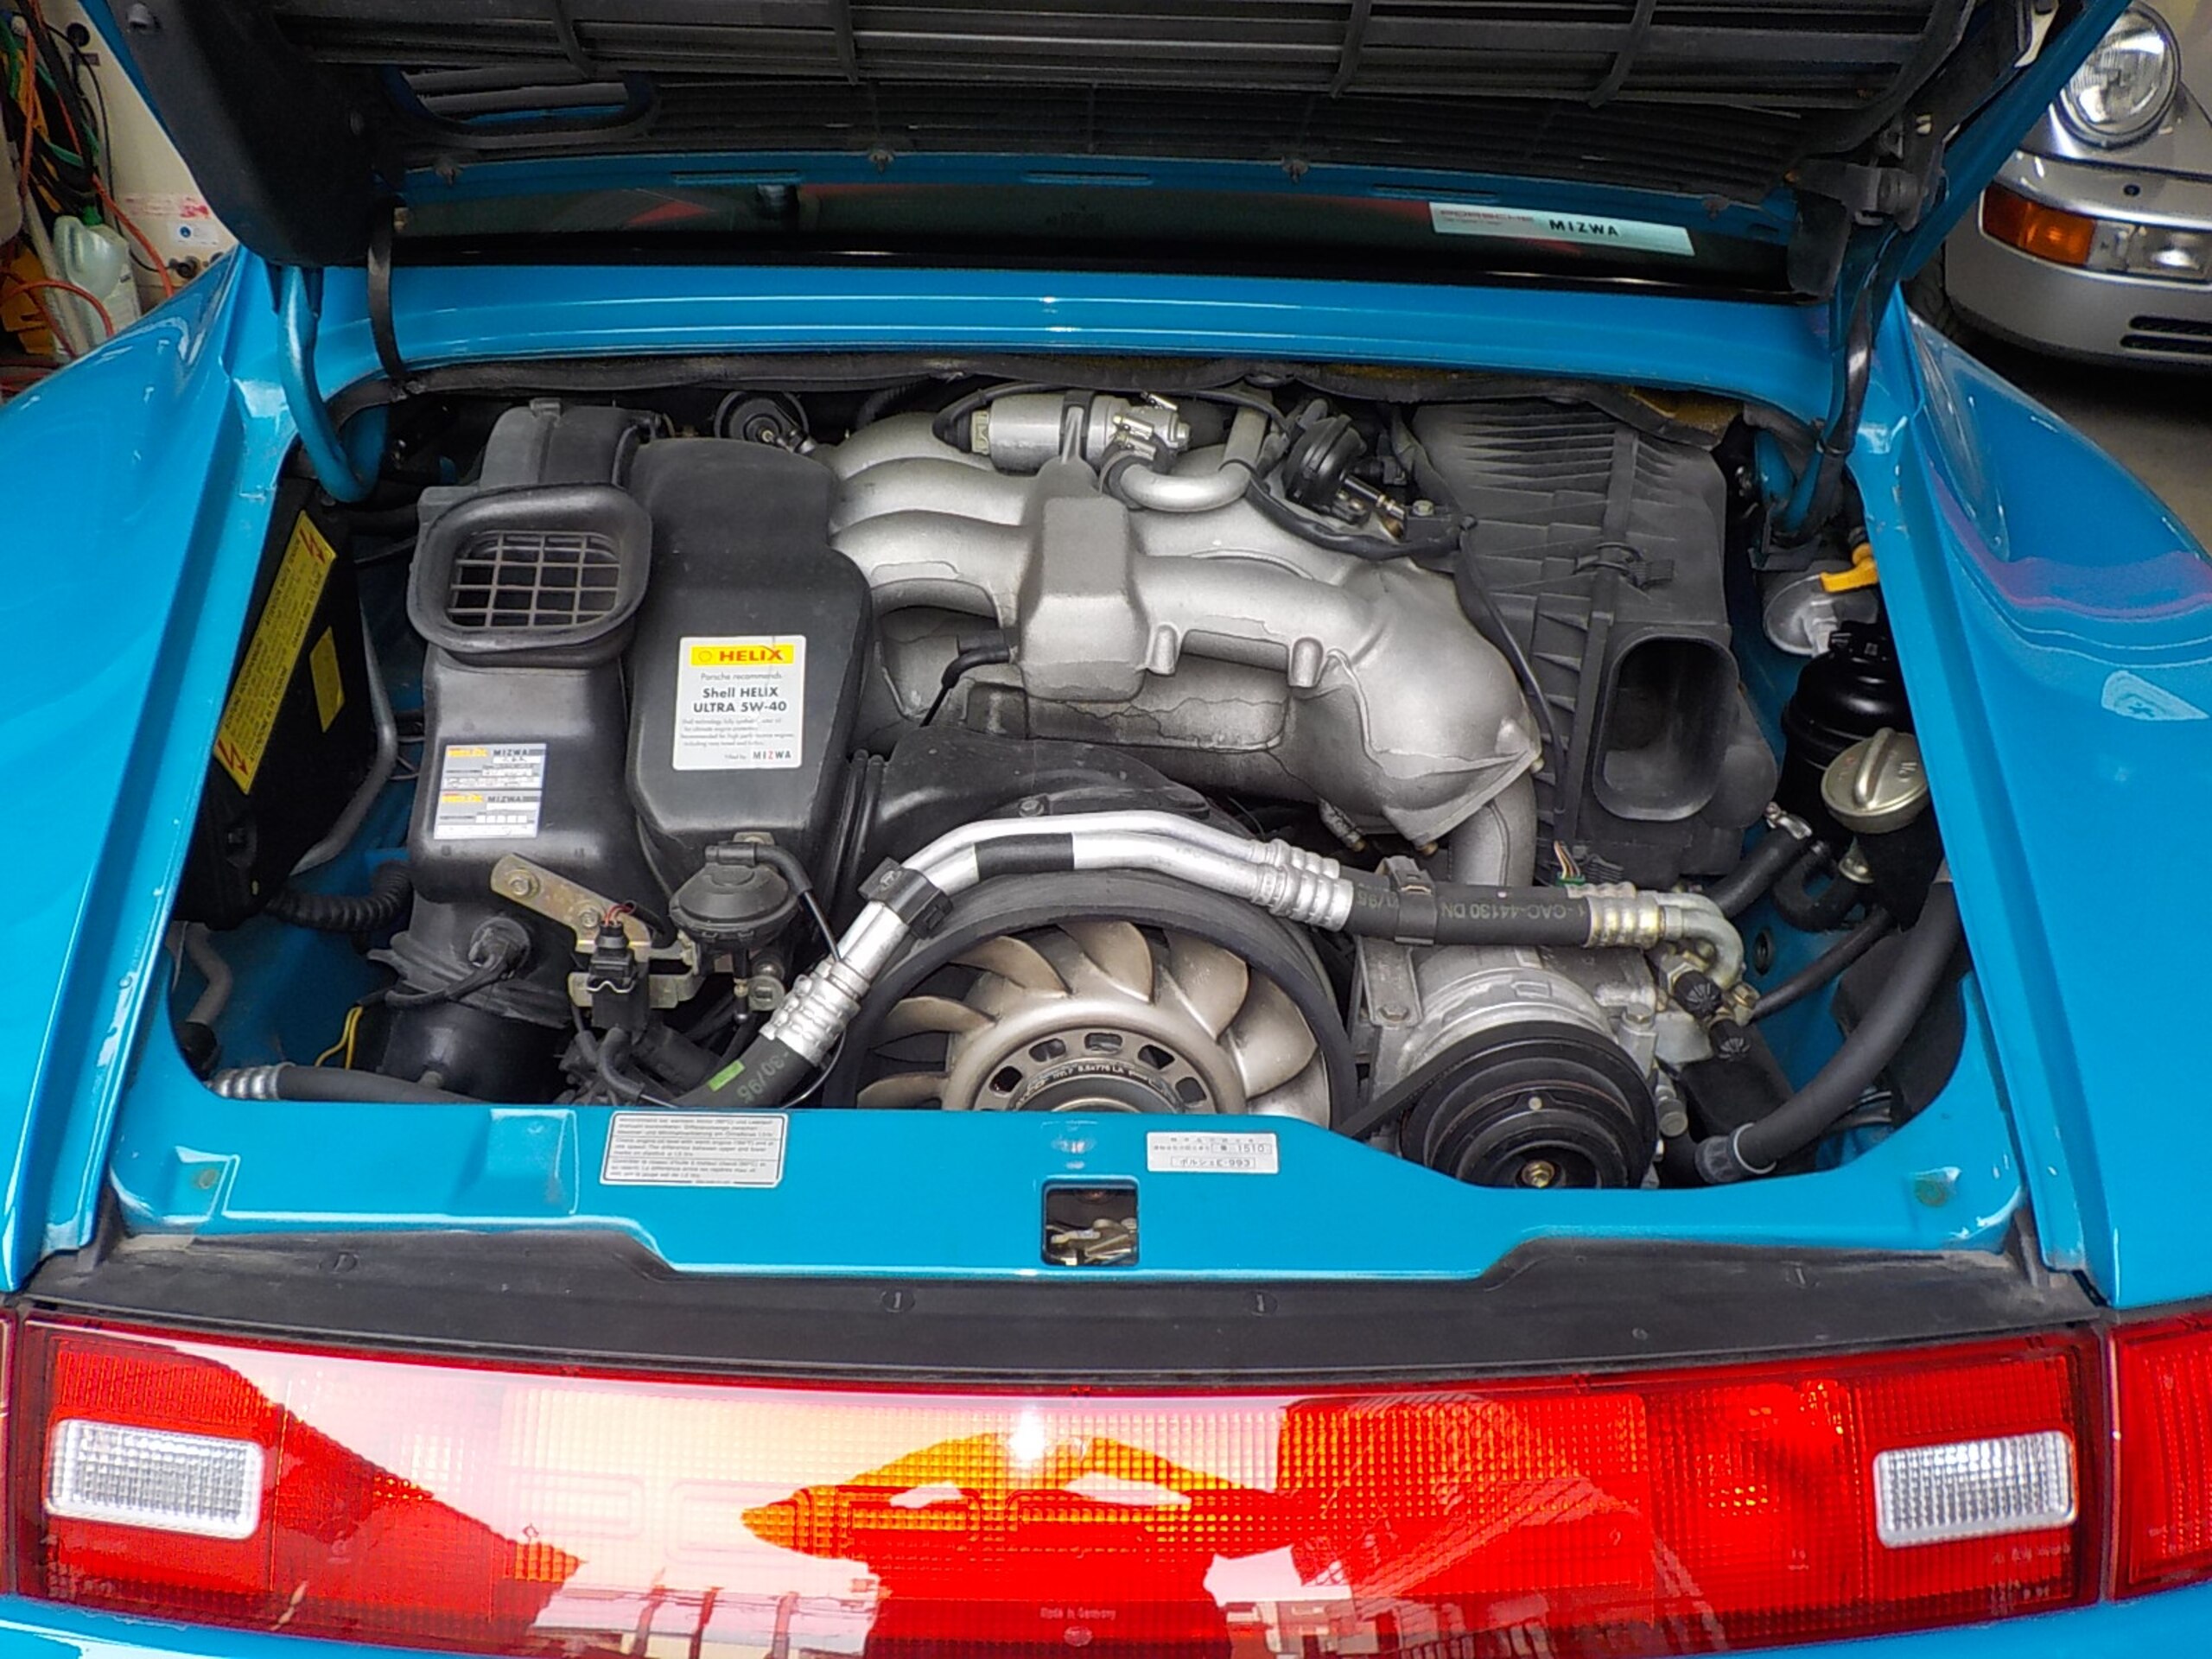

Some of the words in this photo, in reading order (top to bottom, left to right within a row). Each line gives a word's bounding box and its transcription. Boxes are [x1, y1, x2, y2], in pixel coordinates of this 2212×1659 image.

[1549, 219, 1619, 237] MIZWA
[719, 646, 784, 662] HELIX
[702, 687, 735, 698] Shell
[740, 686, 779, 697] HELIX
[694, 702, 735, 713] ULTRA
[741, 701, 787, 712] 5W-40
[493, 748, 528, 757] MIZWA
[753, 750, 791, 760] MIZWA
[1238, 1143, 1265, 1153] 1510
